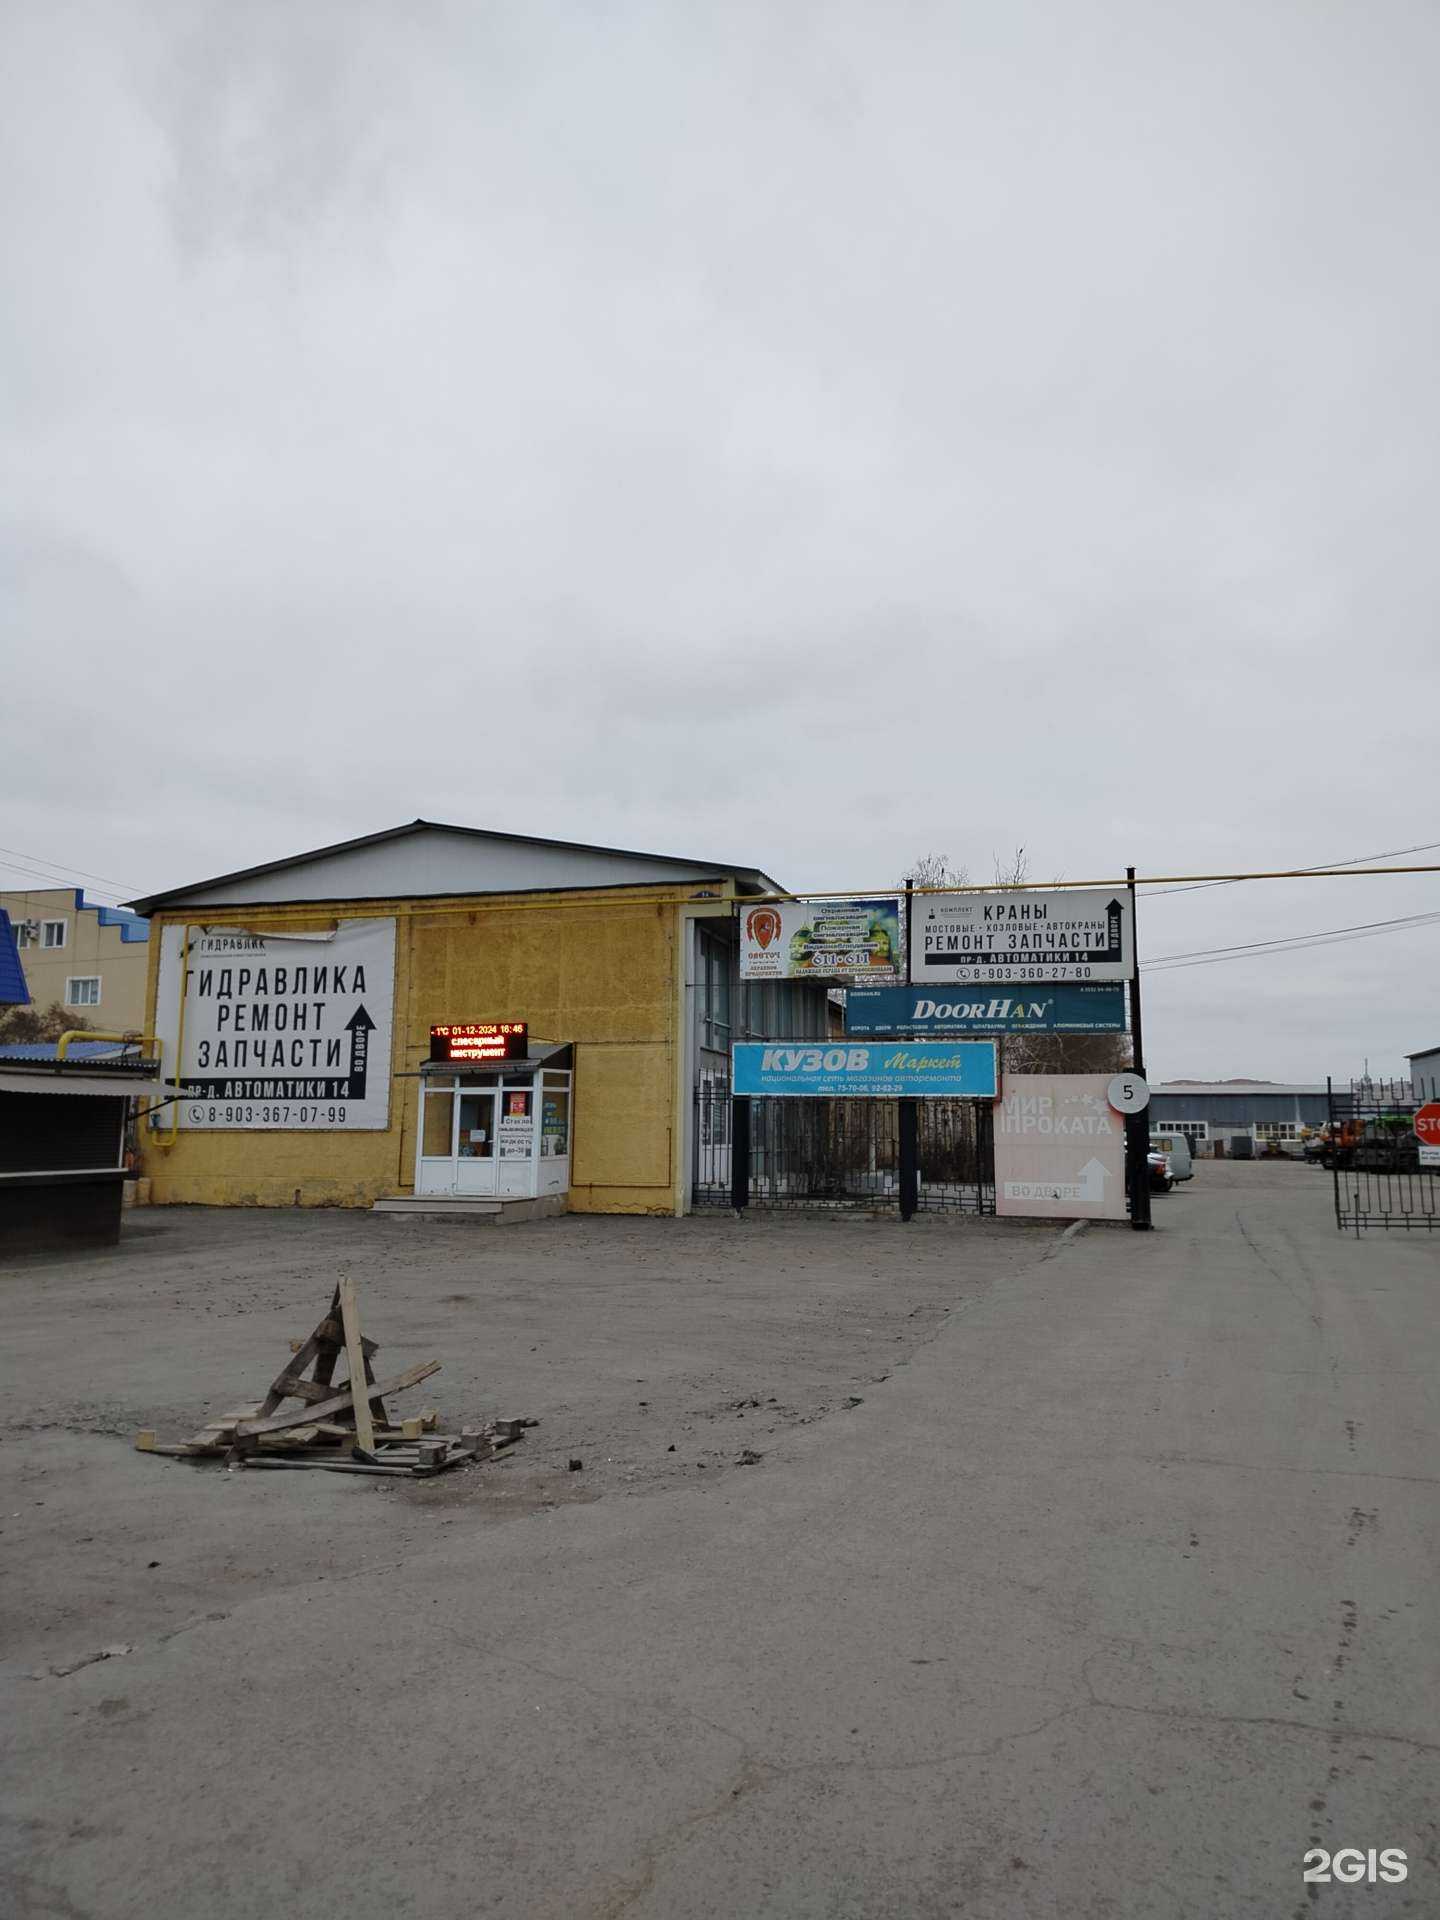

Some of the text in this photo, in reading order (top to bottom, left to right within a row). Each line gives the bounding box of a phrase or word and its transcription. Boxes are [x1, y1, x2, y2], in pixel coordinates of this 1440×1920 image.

[984, 904, 1047, 921] КРАНЫ
[925, 921, 1105, 933] МОСТОВЫЕ КОЗЛОВЫЕ АВТОКРАНЫ
[925, 932, 1105, 950] РЕМОНТ ЗАПЧАСТИ
[990, 952, 1070, 963] АВТОМАТИКИ
[1074, 951, 1088, 962] 14
[973, 967, 1091, 979] 8-903-360-27-80
[184, 966, 366, 999] ГИДРАВЛИКА
[217, 1003, 325, 1032] РЕМОНТ
[452, 1025, 497, 1035] 01-12-2024
[354, 1025, 366, 1072] ВО ДВОРЕ
[451, 1035, 505, 1047] слесарный
[198, 1039, 341, 1068] ЗАПЧАСТИ
[450, 1048, 506, 1059] инструмент
[761, 1049, 962, 1072] КУЗОВ Маркет
[225, 1080, 326, 1098] АВТОМАТИКИ
[332, 1080, 349, 1097] 14
[1123, 1085, 1133, 1099] 5
[1001, 1096, 1052, 1114] МИР
[209, 1107, 346, 1123] 8-903-367-07-99
[1000, 1116, 1112, 1134] ПРОКАТА
[1012, 1186, 1030, 1197] ВО
